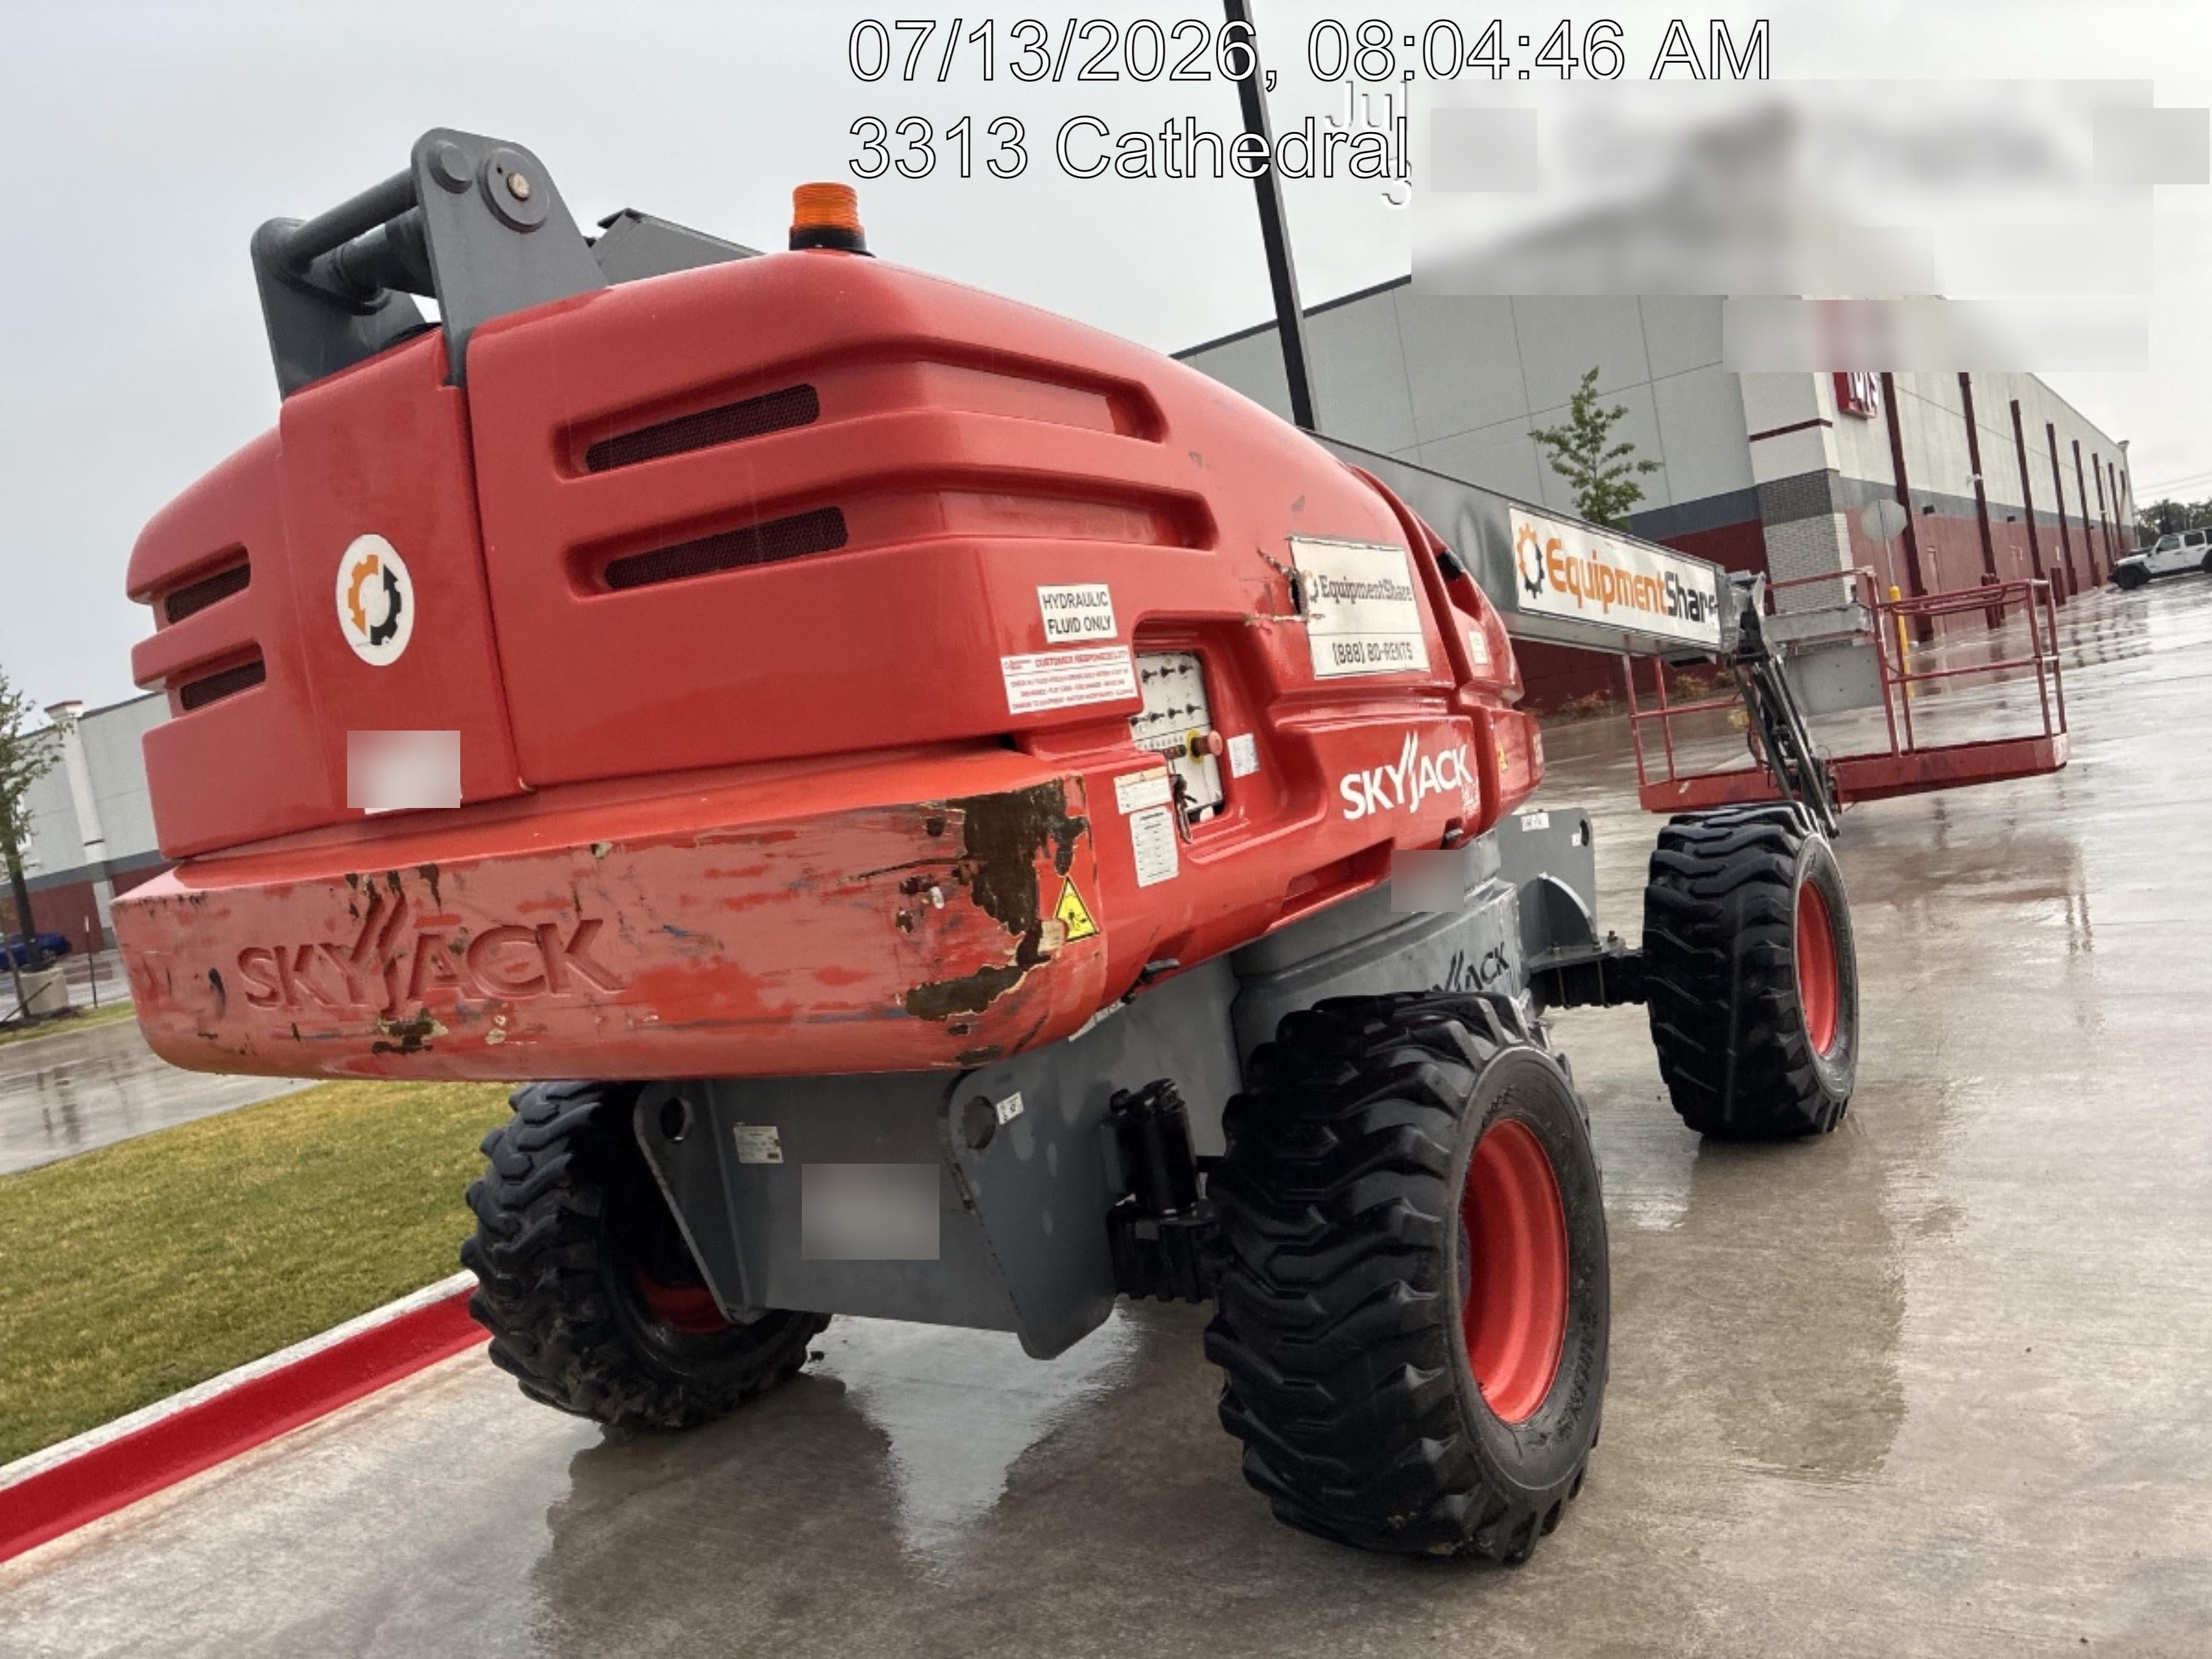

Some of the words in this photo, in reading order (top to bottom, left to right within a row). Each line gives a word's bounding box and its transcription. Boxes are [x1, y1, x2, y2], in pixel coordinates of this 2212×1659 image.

[1043, 591, 1108, 610] HYDRAULIC
[1319, 575, 1413, 605] EquipmentShare
[1048, 617, 1081, 635] FLUID
[1084, 615, 1111, 631] ONLY
[1332, 641, 1365, 665] (888)
[1339, 731, 1473, 820] SKYJACK
[237, 891, 626, 1019] SKYJACK
